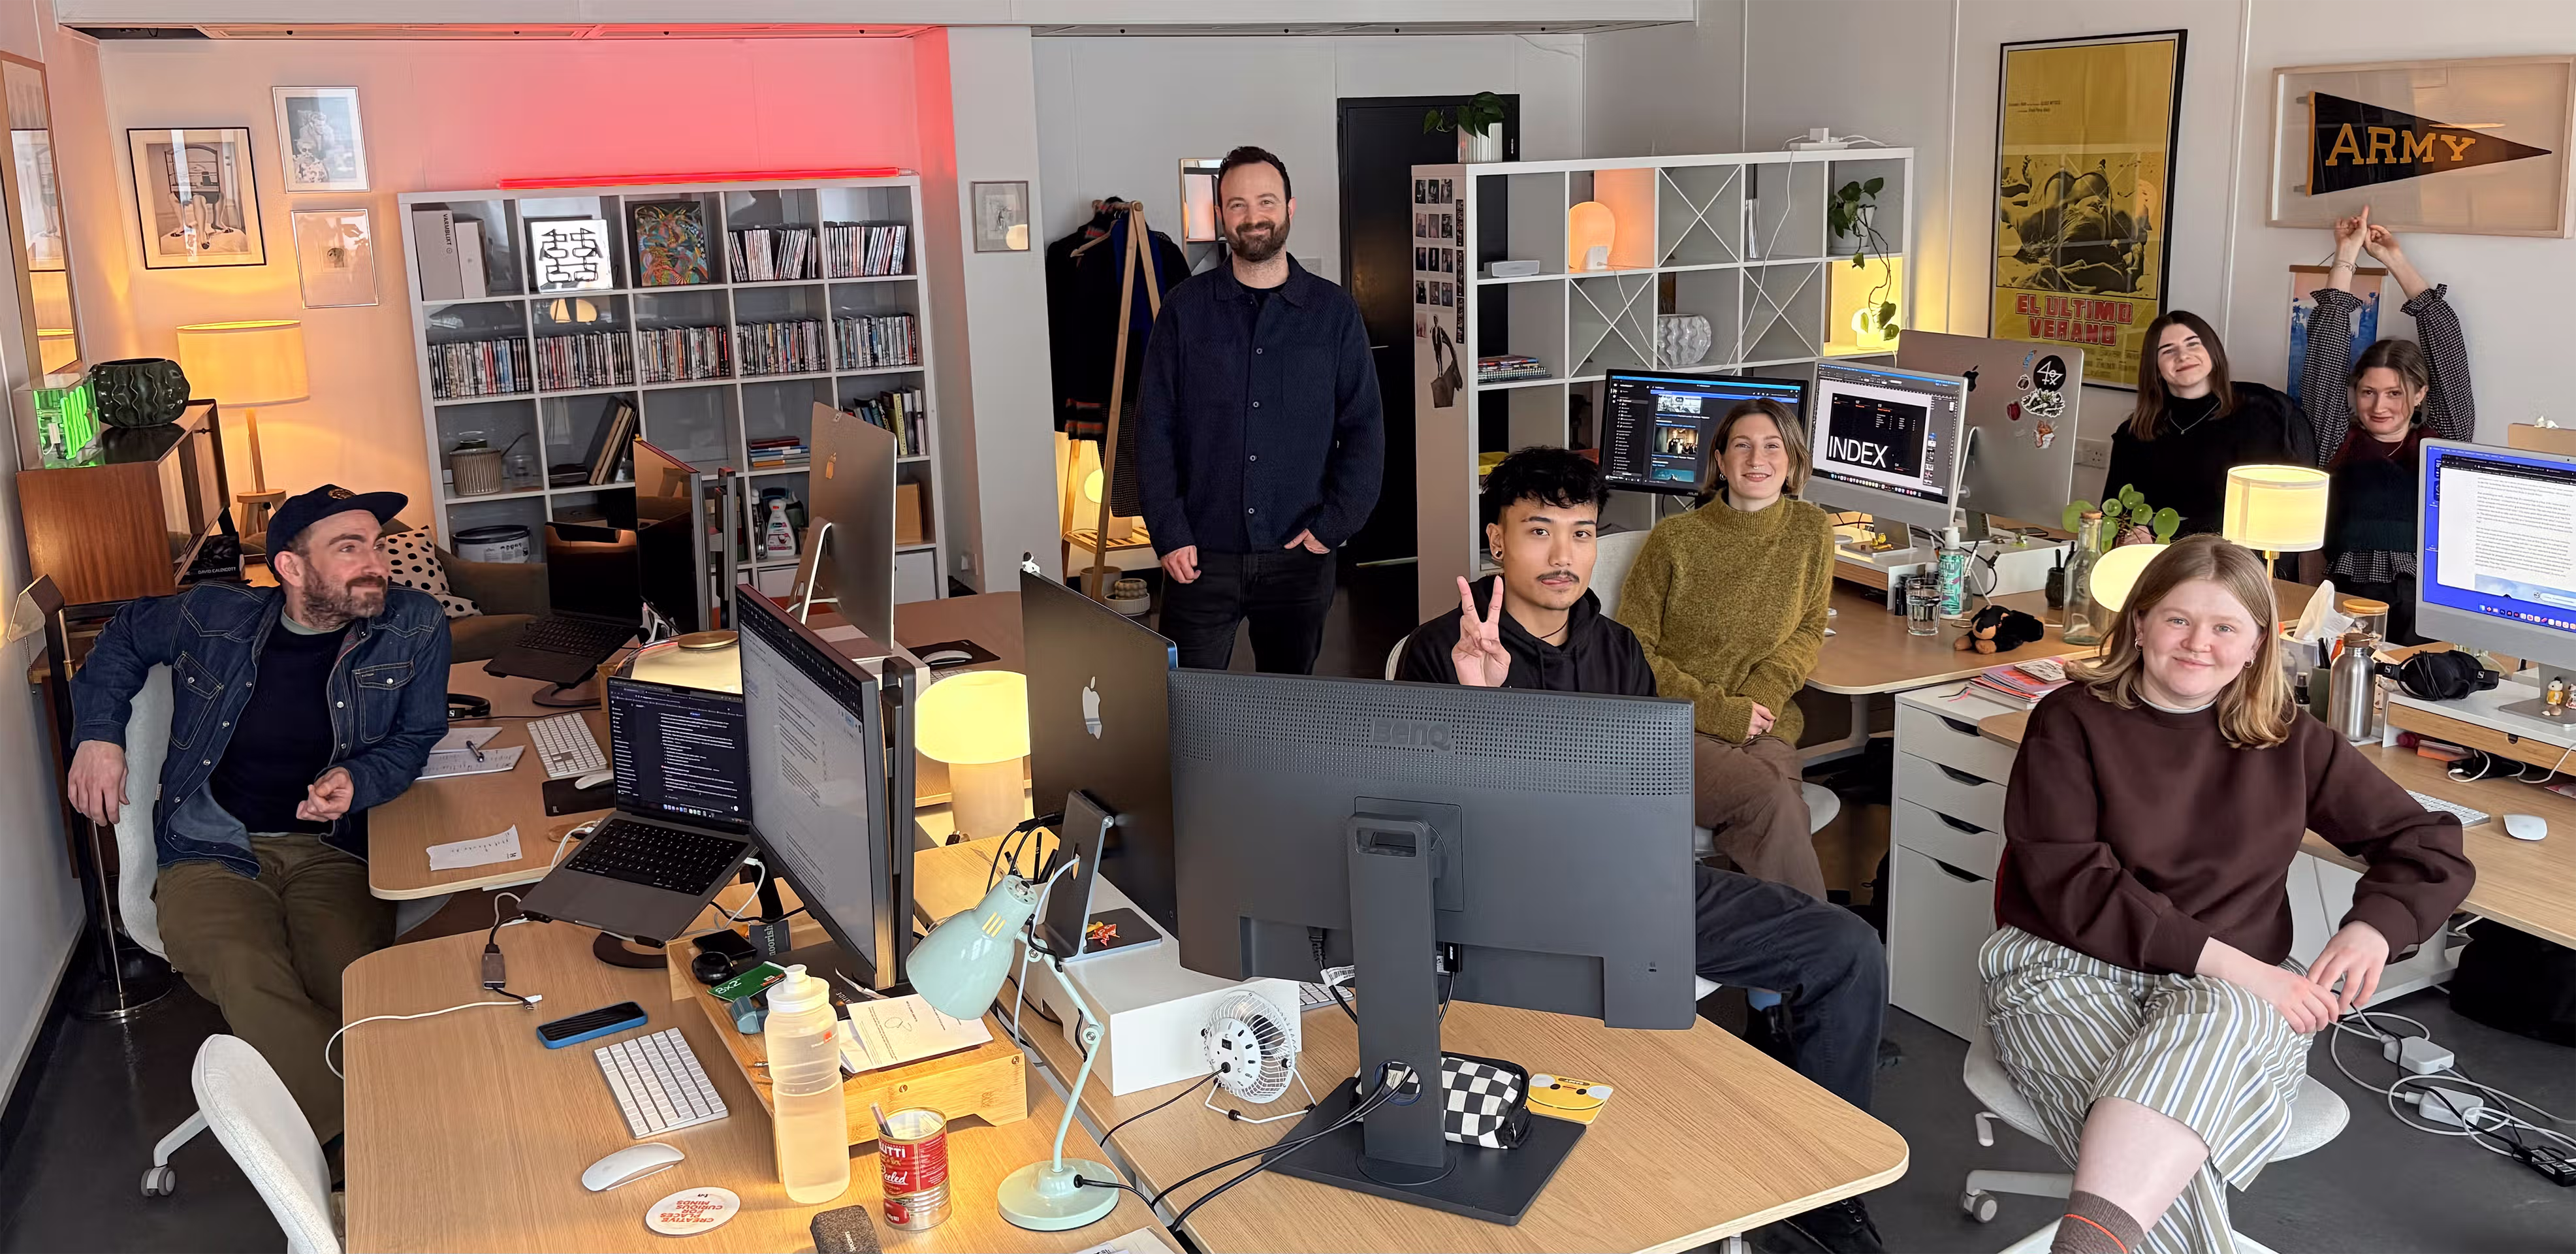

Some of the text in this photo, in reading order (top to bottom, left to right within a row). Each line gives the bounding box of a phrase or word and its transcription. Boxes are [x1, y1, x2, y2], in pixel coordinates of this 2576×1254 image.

[2325, 123, 2476, 166] ARMY
[443, 213, 452, 245] VARMBLIXT
[2016, 293, 2133, 325] EL ULTIMO
[2028, 316, 2116, 346] VERANO
[1828, 436, 1889, 468] INDEX
[764, 924, 776, 956] noorish
